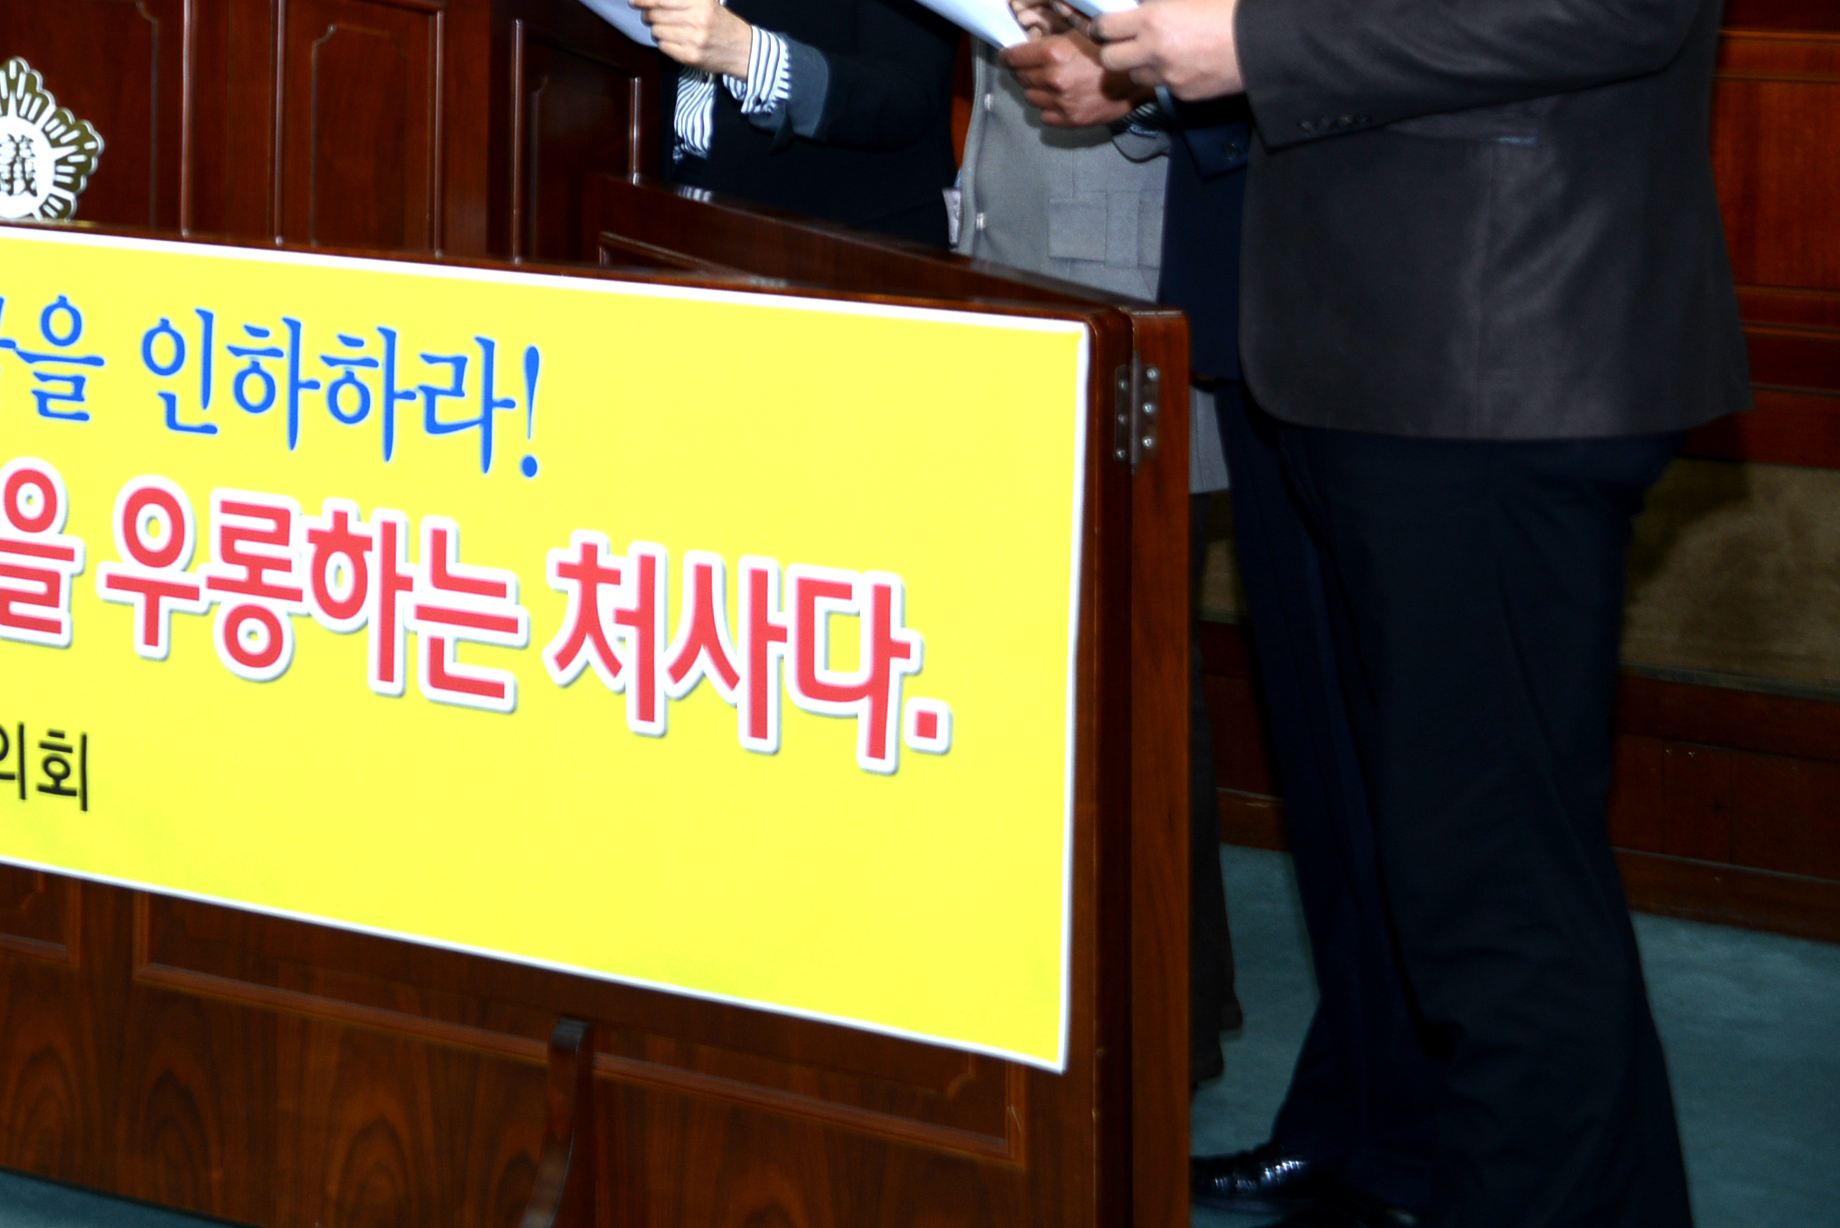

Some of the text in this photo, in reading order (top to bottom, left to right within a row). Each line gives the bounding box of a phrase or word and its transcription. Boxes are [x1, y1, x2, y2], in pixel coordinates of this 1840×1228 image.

[141, 307, 541, 479] 인하하라!
[106, 488, 519, 699] 우롱하는
[555, 543, 938, 760] 처사다.
